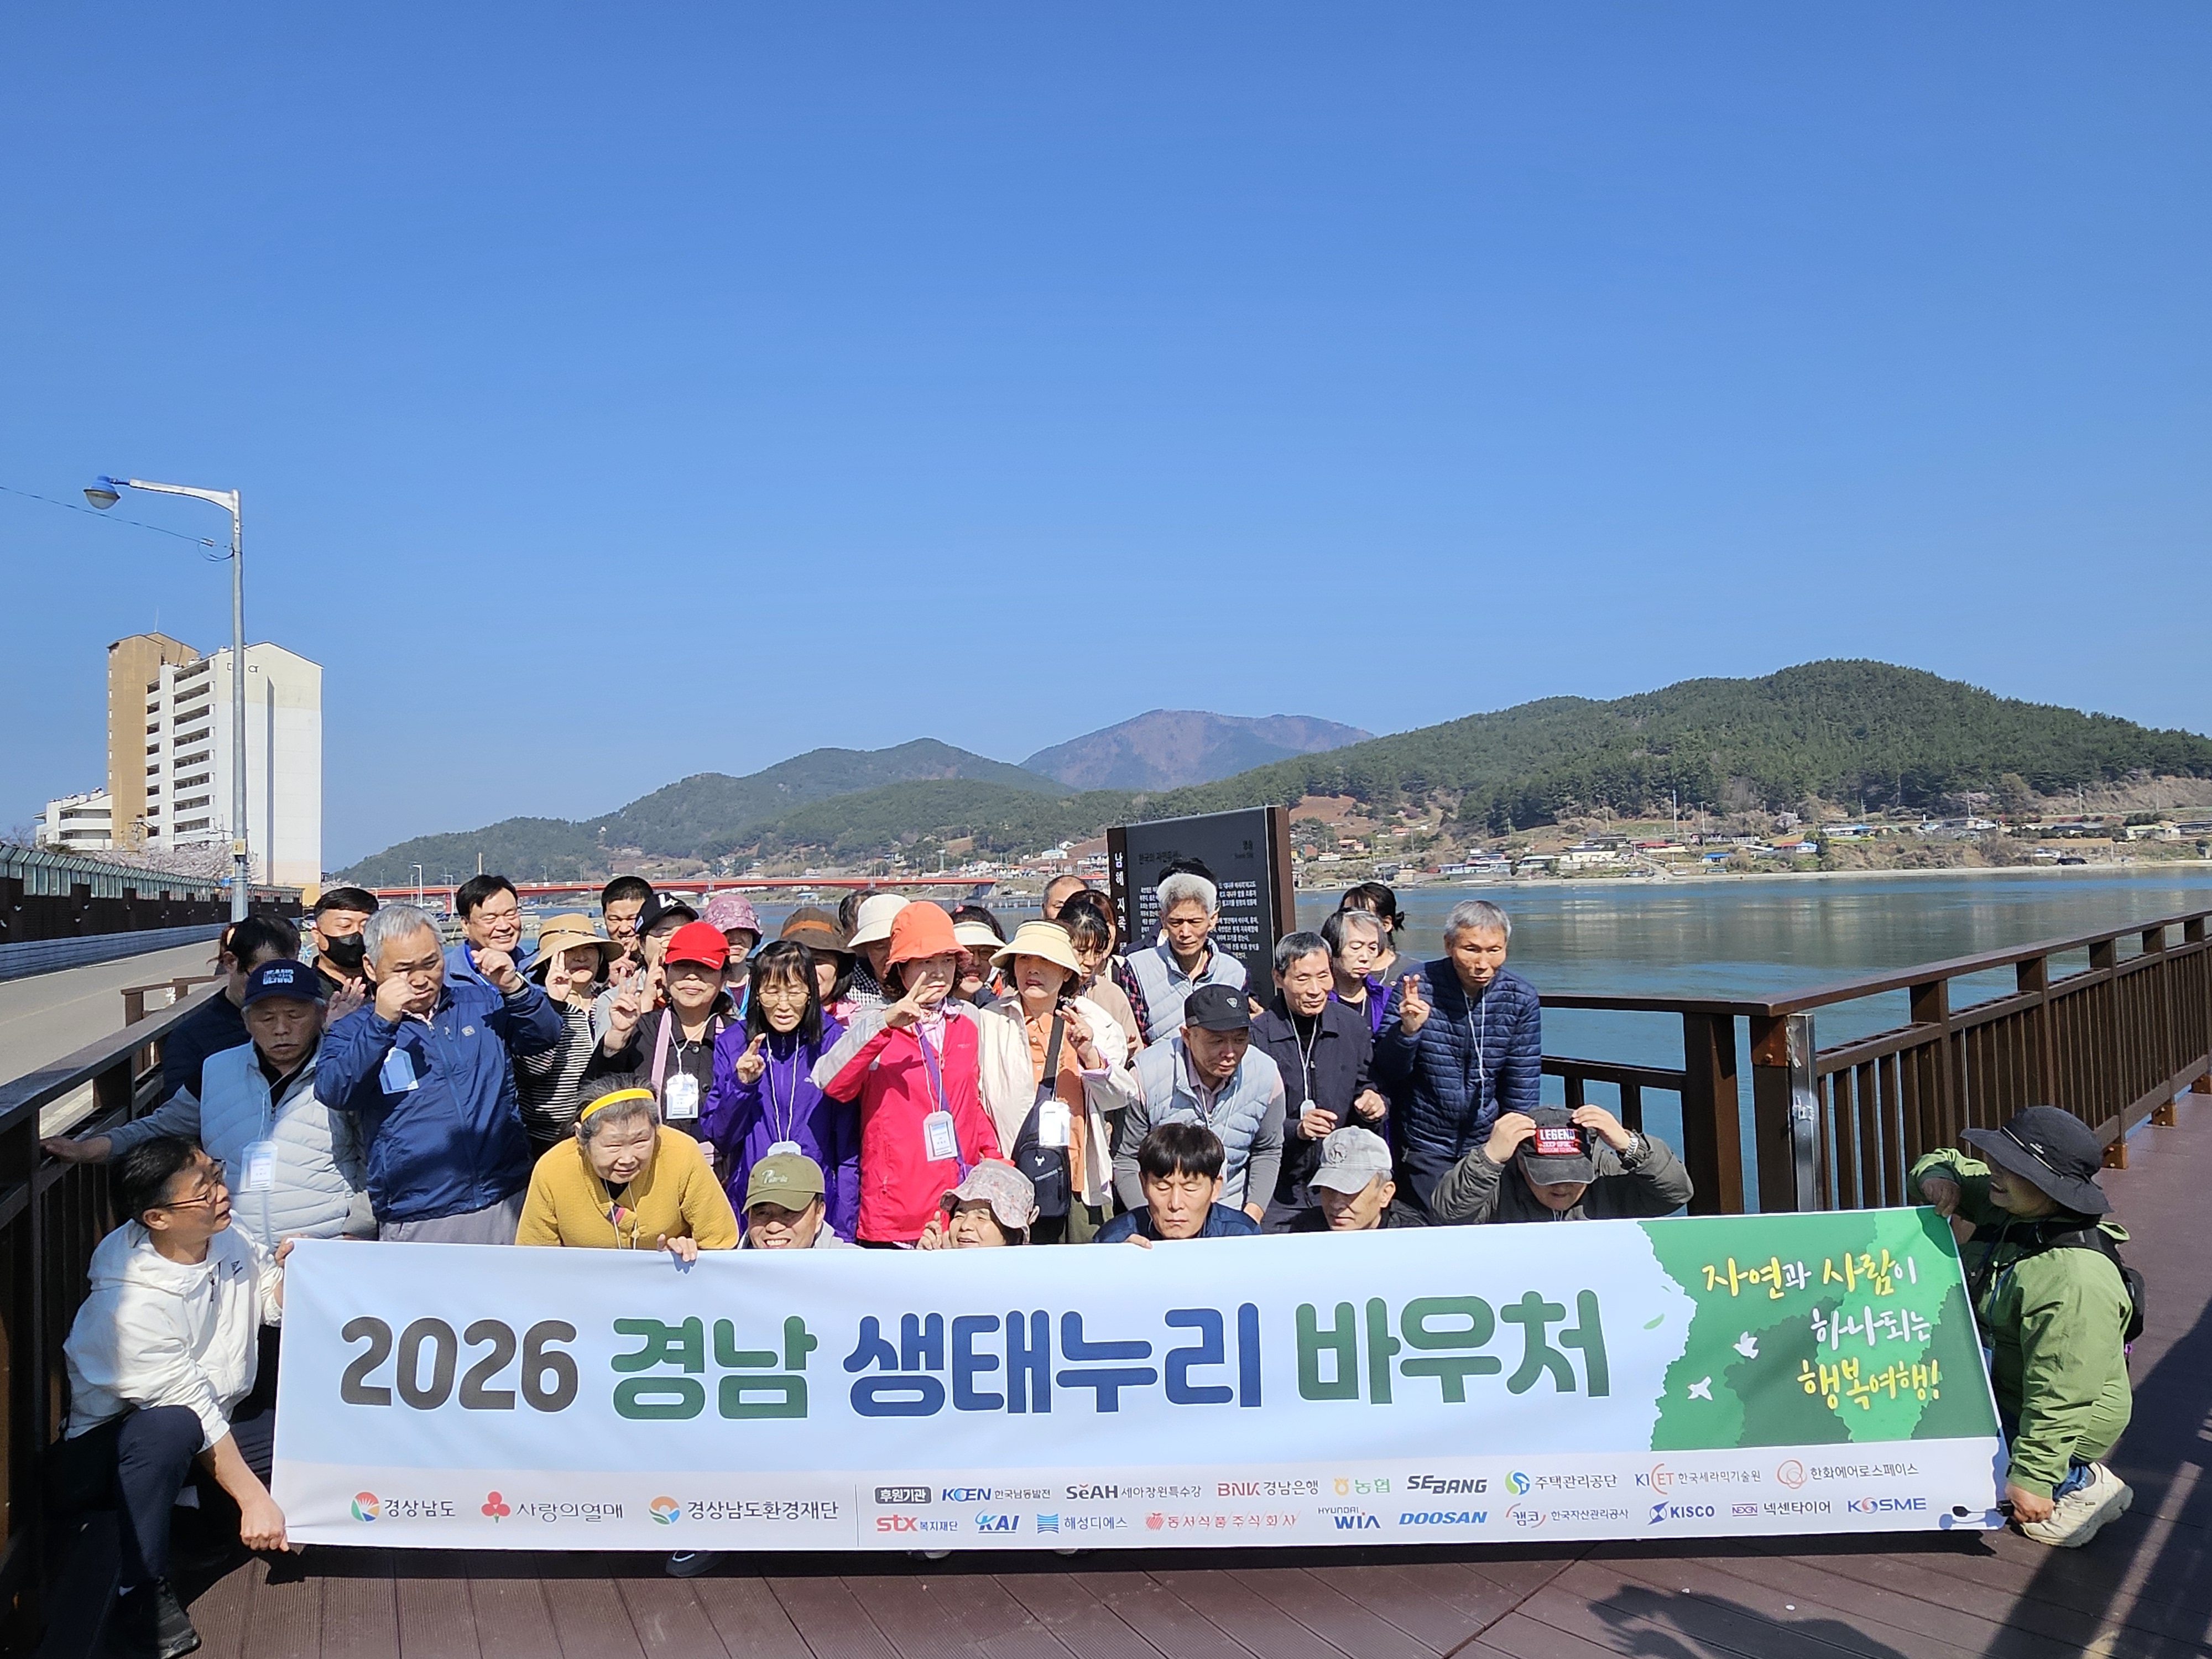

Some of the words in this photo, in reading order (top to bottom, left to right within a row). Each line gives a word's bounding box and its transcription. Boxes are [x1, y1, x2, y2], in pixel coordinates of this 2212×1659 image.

[1702, 1256, 1812, 1300] 자연과
[1823, 1248, 1918, 1296] 사람이
[1811, 1306, 1931, 1350] 하나되는
[340, 1316, 578, 1412] 2026
[611, 1315, 818, 1420] 경남
[843, 1302, 1261, 1417] 생태누리
[1296, 1289, 1610, 1404] 바우처
[1797, 1357, 1940, 1410] 행복여행!
[1635, 1472, 1674, 1486] KICET
[1678, 1469, 1761, 1484] 한국세라믹기술원
[1810, 1463, 1919, 1480] 한화에어로스페이스
[1217, 1482, 1261, 1496] BNK
[1264, 1480, 1319, 1496] 경남은행
[1355, 1478, 1390, 1494] 농협
[1407, 1475, 1487, 1494] SEBANG
[1535, 1474, 1618, 1490] 주택관리공단
[880, 1489, 926, 1502] 후원기관
[942, 1488, 991, 1502] KOEN
[994, 1488, 1051, 1500] 한국남동발전
[384, 1499, 456, 1518] 경상남도
[517, 1501, 623, 1523] 사랑의열매
[687, 1500, 839, 1521] 경상남도환경재단
[1670, 1505, 1715, 1519] KISCO
[1764, 1500, 1831, 1516] 넥센타이어
[1848, 1496, 1927, 1514] KOSME
[920, 1520, 958, 1532] 복지재단
[977, 1514, 1020, 1532] KAI
[1064, 1516, 1128, 1530] 해성디에스
[1167, 1514, 1298, 1529] 동서식품주식회사
[1334, 1514, 1381, 1530] WIA
[1399, 1511, 1487, 1525] DOOSAN
[1512, 1510, 1540, 1527] 캠코
[1551, 1508, 1629, 1521] 한국자산관리공사
